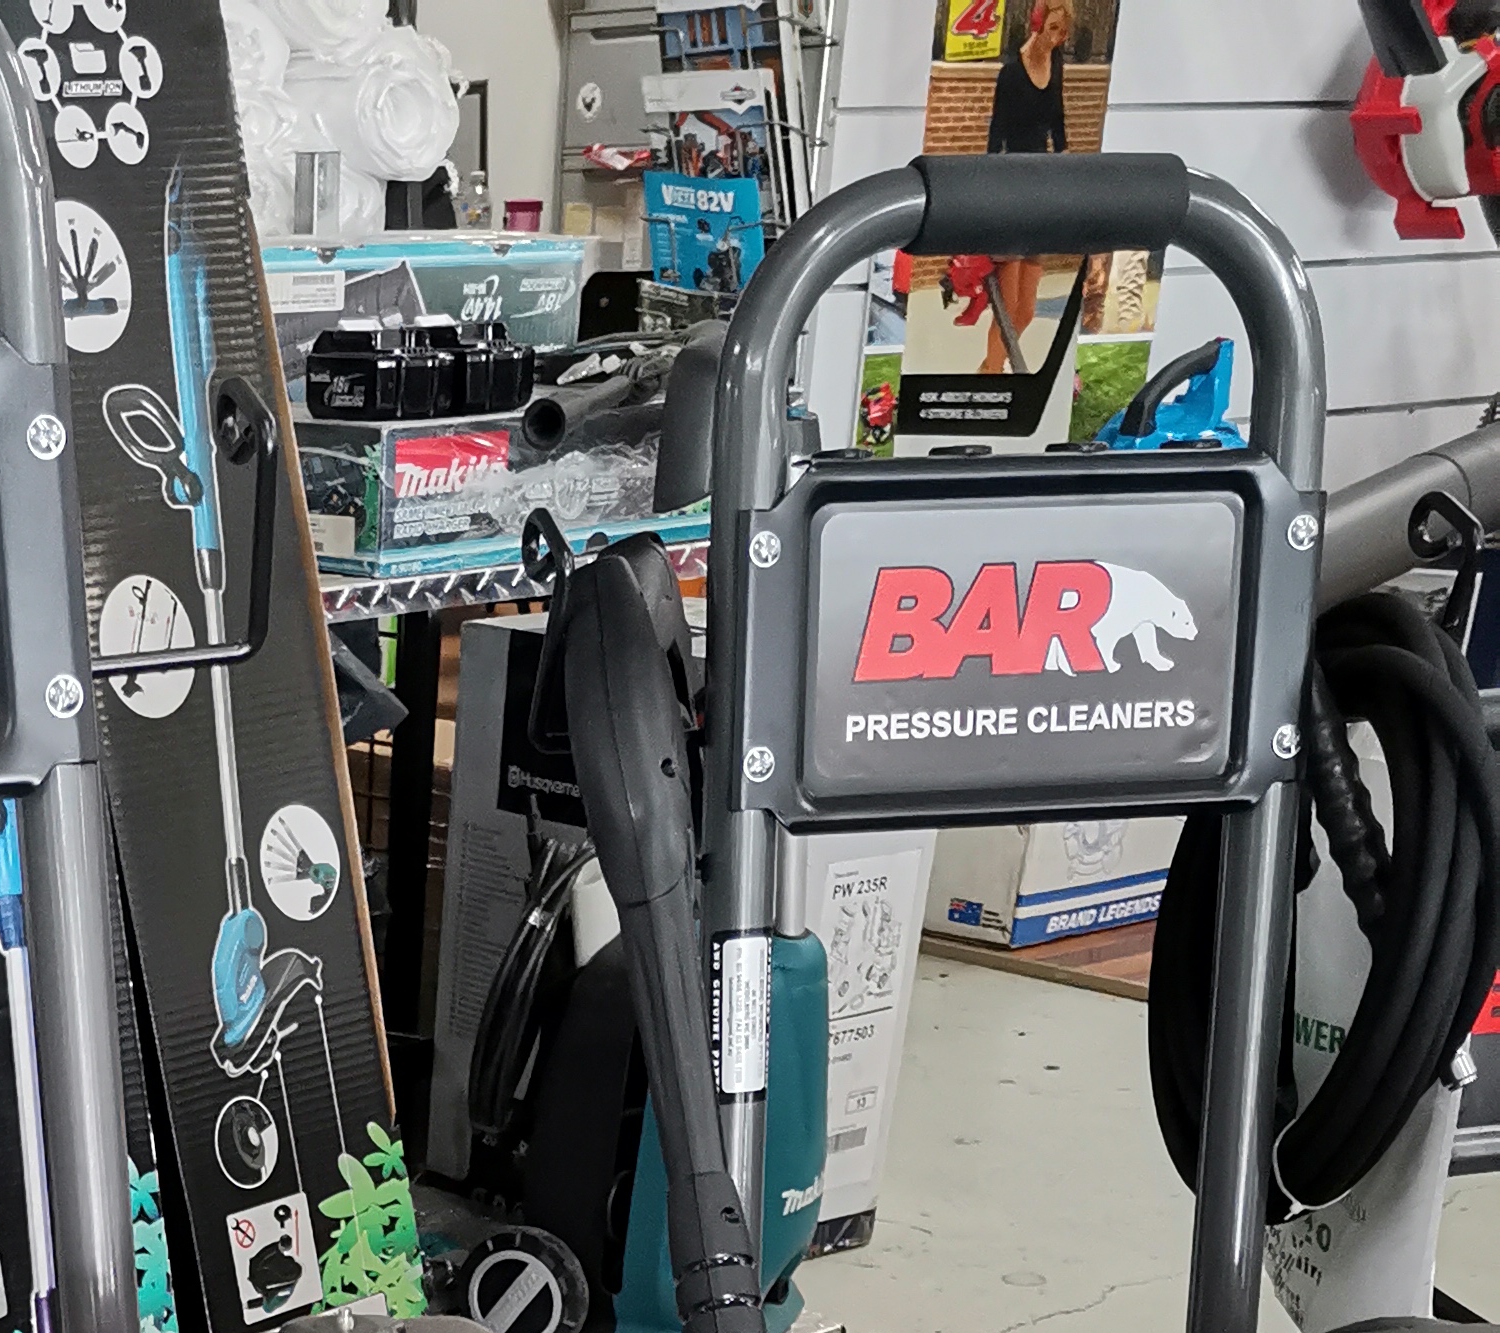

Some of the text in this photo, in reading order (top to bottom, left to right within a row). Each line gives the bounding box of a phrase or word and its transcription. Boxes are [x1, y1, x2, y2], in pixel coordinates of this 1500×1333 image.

[852, 560, 1112, 684] BAR
[846, 700, 1195, 742] PRESSURE CLEANERS
[832, 876, 887, 900] PW 235R
[1046, 895, 1162, 934] BRAND LEGENDS
